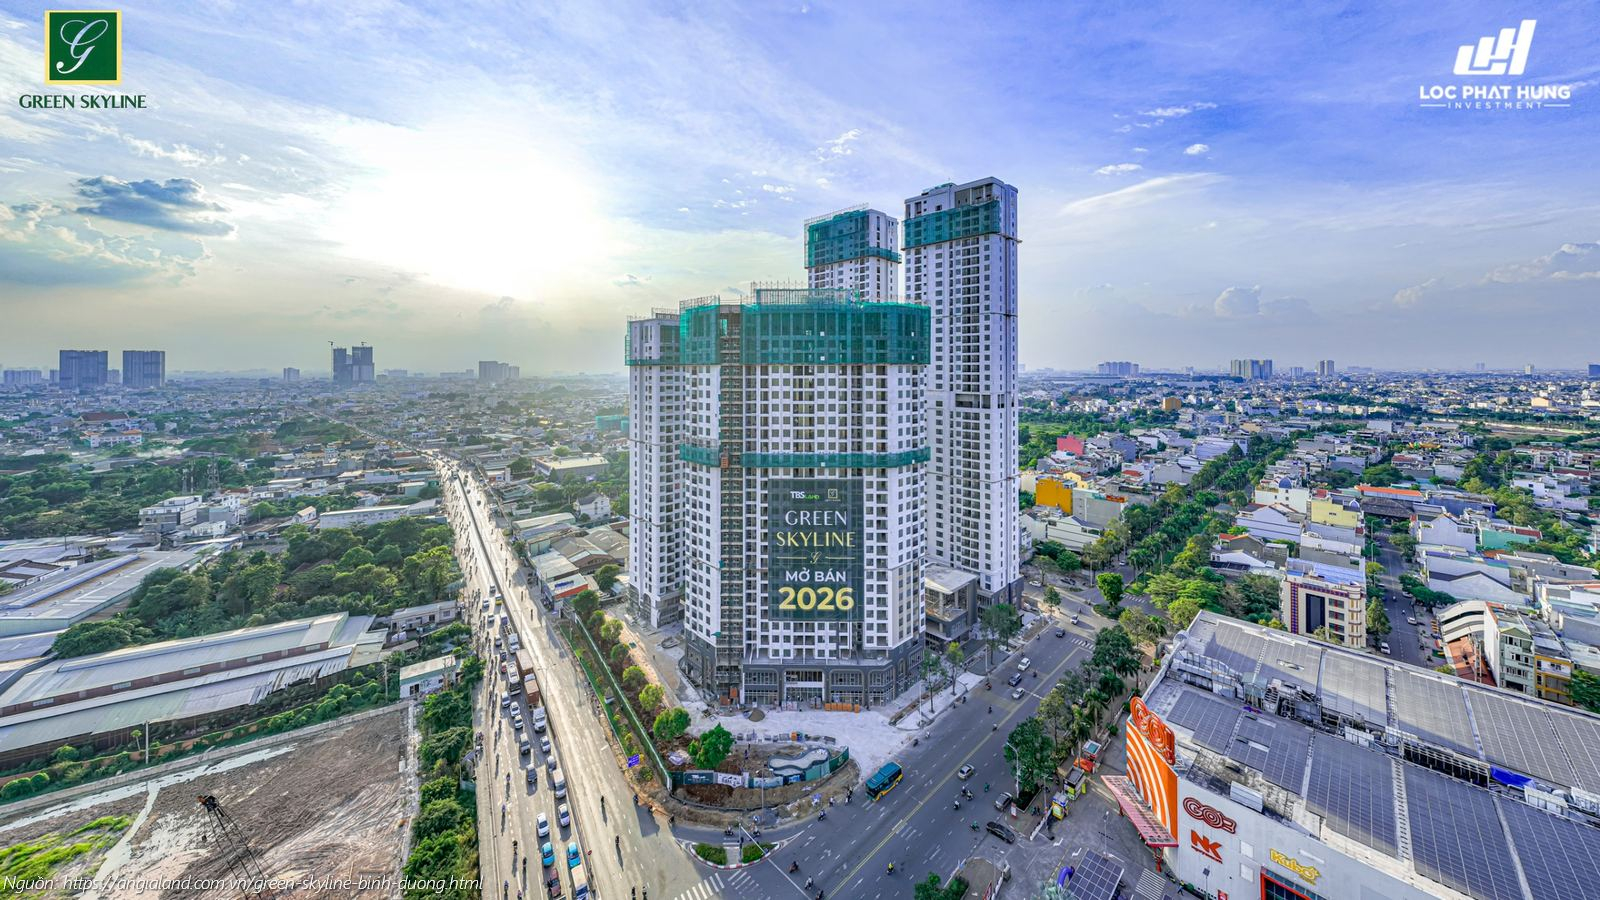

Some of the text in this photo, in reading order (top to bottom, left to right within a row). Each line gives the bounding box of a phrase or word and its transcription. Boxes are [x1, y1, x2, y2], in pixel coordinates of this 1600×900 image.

[790, 491, 805, 499] TBS
[784, 510, 847, 526] GREEN
[776, 531, 856, 547] SKYLINE
[785, 567, 847, 582] MỞ BÁN
[778, 586, 855, 611] 2026
[1191, 829, 1223, 861] NK
